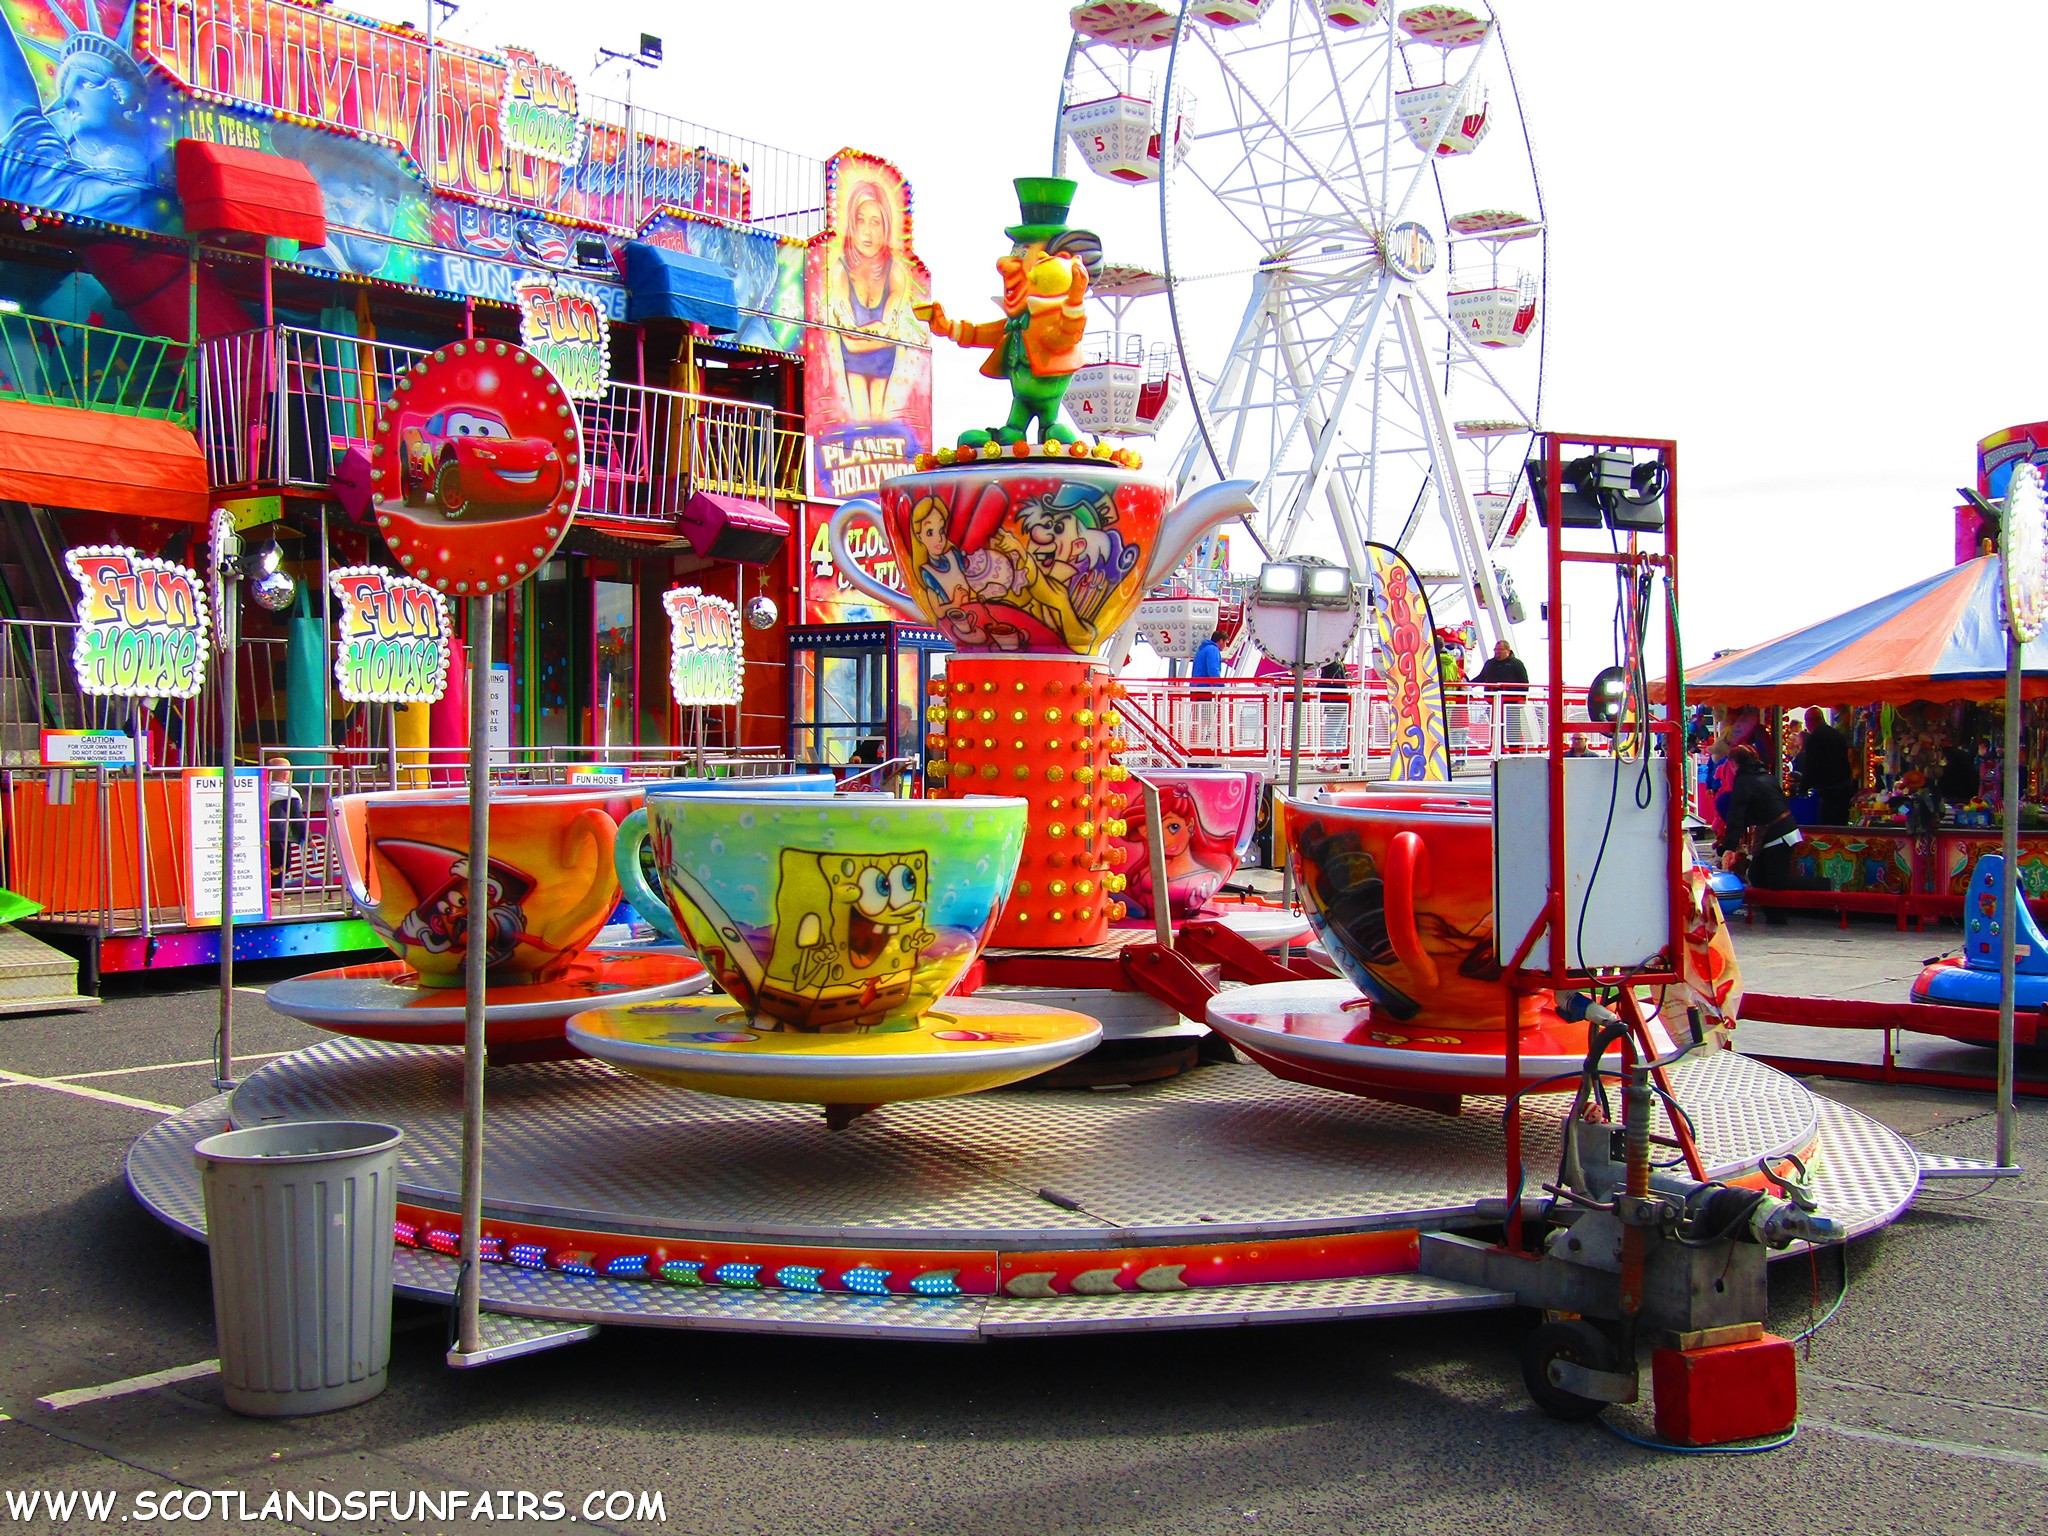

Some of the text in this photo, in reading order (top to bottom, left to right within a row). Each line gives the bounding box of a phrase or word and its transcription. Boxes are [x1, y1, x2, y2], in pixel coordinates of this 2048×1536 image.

[503, 47, 578, 117] Fun
[190, 110, 260, 150] LAS VEGAS
[507, 101, 576, 159] House
[1094, 136, 1106, 153] 5
[454, 203, 621, 281] USA
[443, 255, 513, 300] FUN
[517, 285, 602, 345] Fun
[1471, 318, 1481, 330] 4
[1083, 400, 1094, 415] 4
[821, 437, 907, 469] PLANET
[810, 522, 834, 578] 4
[75, 556, 200, 630] Fun
[339, 574, 442, 641] Fun
[670, 594, 736, 652] Fun
[1160, 630, 1172, 644] 3
[83, 625, 197, 691] House
[345, 638, 440, 695] House
[678, 649, 736, 699] House
[196, 778, 254, 789] FUN HUSE
[576, 775, 619, 785] FUN HOUSE
